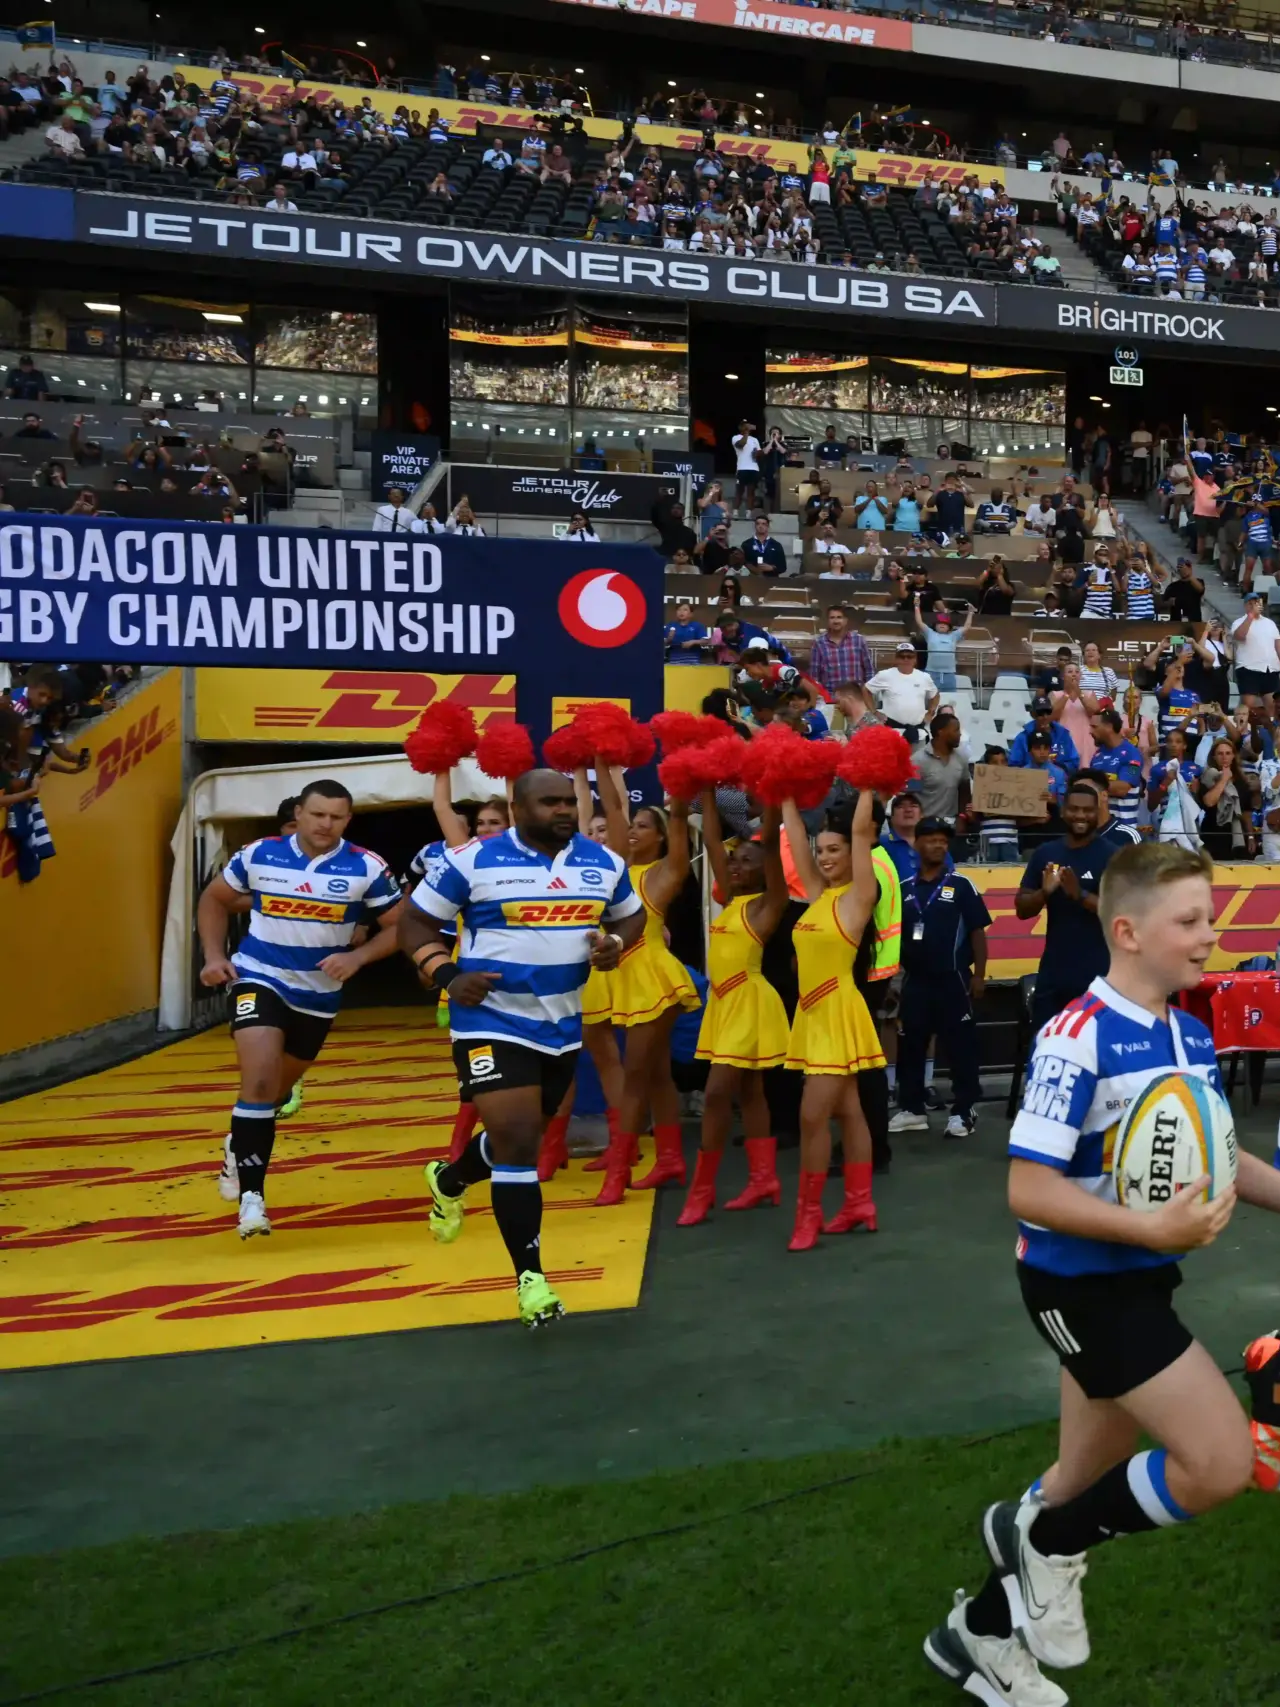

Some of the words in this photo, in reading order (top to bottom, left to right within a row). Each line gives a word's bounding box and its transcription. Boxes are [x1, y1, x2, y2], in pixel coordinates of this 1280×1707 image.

[874, 159, 968, 187] DHL
[90, 210, 402, 263] JETOUR
[417, 236, 710, 292] OWNERS
[727, 267, 889, 308] CLUB
[905, 285, 985, 318] SA
[1118, 351, 1135, 360] 101
[382, 454, 430, 466] PRIVATE
[396, 446, 416, 455] VIP
[390, 465, 422, 475] AREA
[675, 463, 693, 472] VIP
[512, 477, 590, 488] JETOUR
[571, 481, 623, 509] Club
[0, 525, 238, 586] ODACOM
[257, 535, 442, 593] UNITED
[107, 593, 516, 656] CHAMPIONSHIP
[94, 705, 168, 792] DHL
[267, 899, 335, 918] DHL
[519, 904, 597, 923] DHL
[1124, 1041, 1151, 1053] VALR
[1149, 1109, 1178, 1203] BERT
